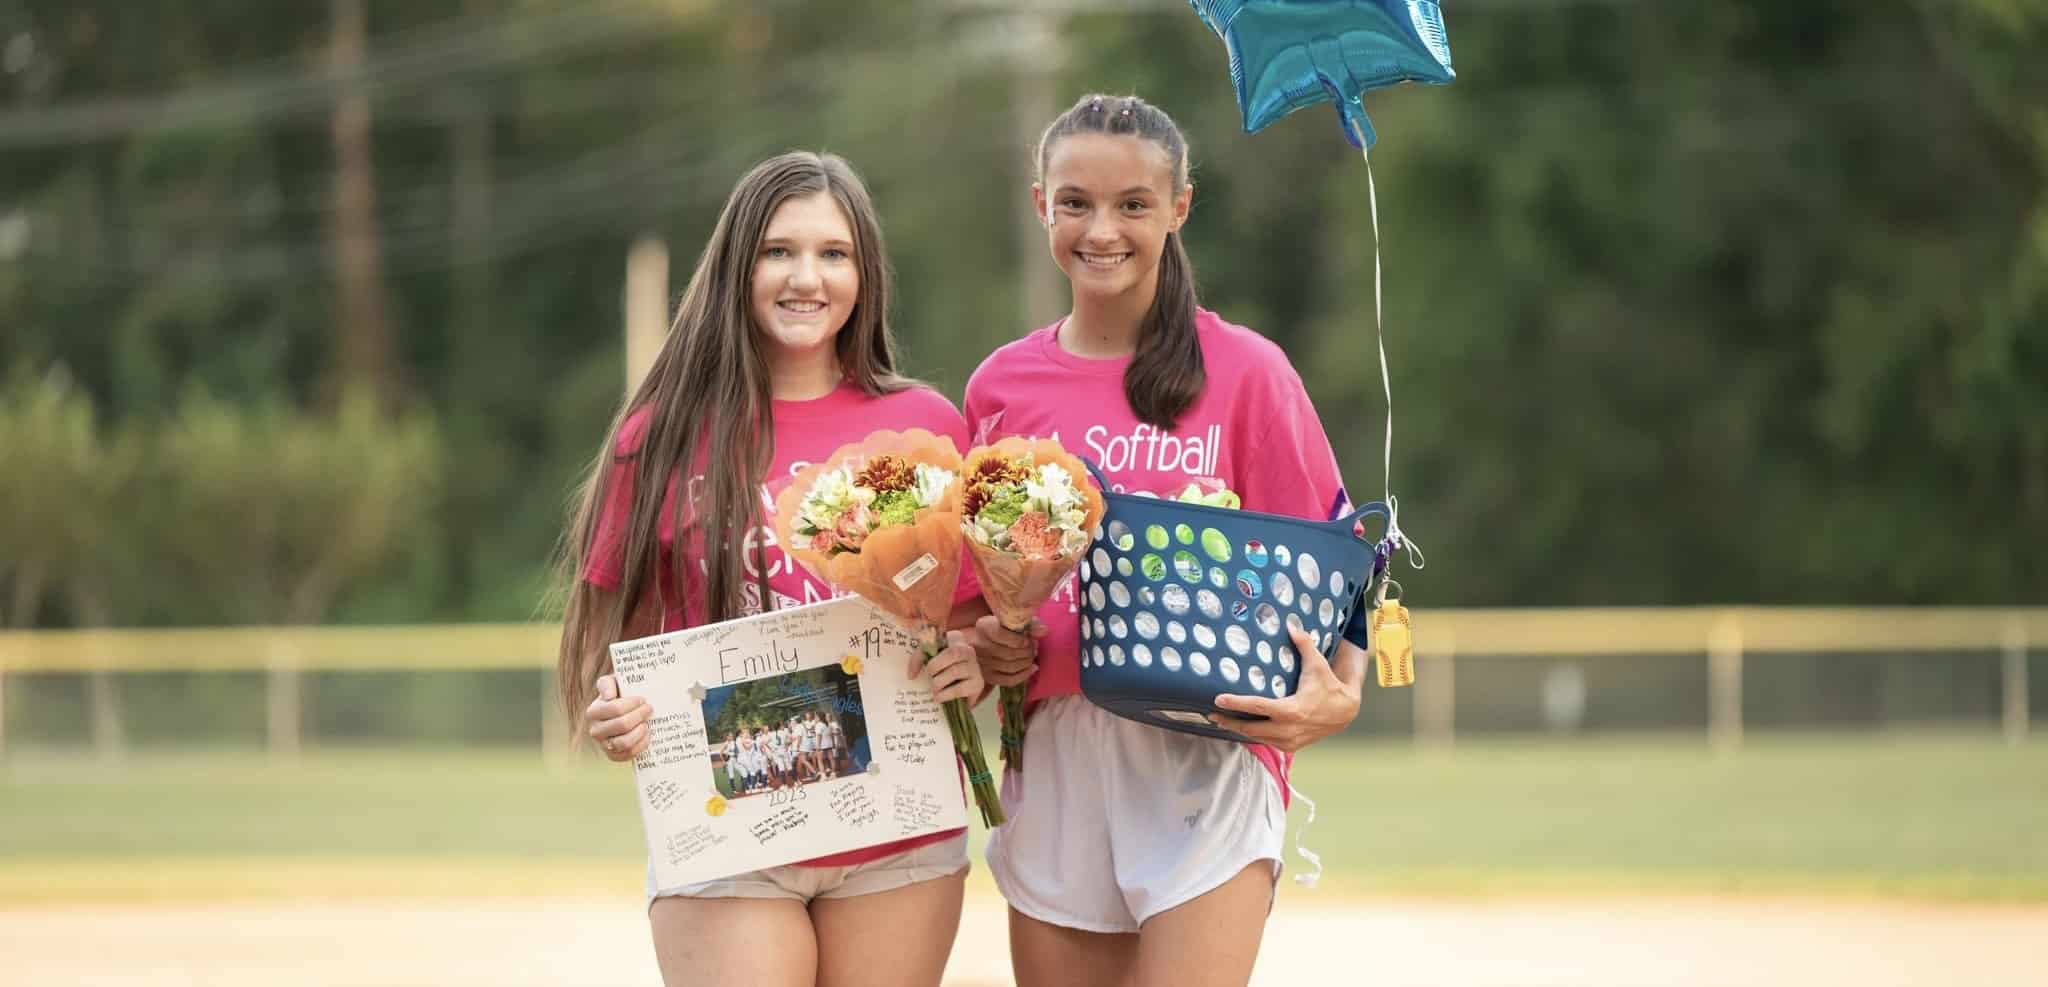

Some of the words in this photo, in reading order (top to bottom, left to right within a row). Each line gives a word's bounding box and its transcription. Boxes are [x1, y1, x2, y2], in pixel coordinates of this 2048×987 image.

[1085, 423, 1221, 475] Softball
[719, 639, 799, 685] Emily
[848, 626, 881, 660] #19
